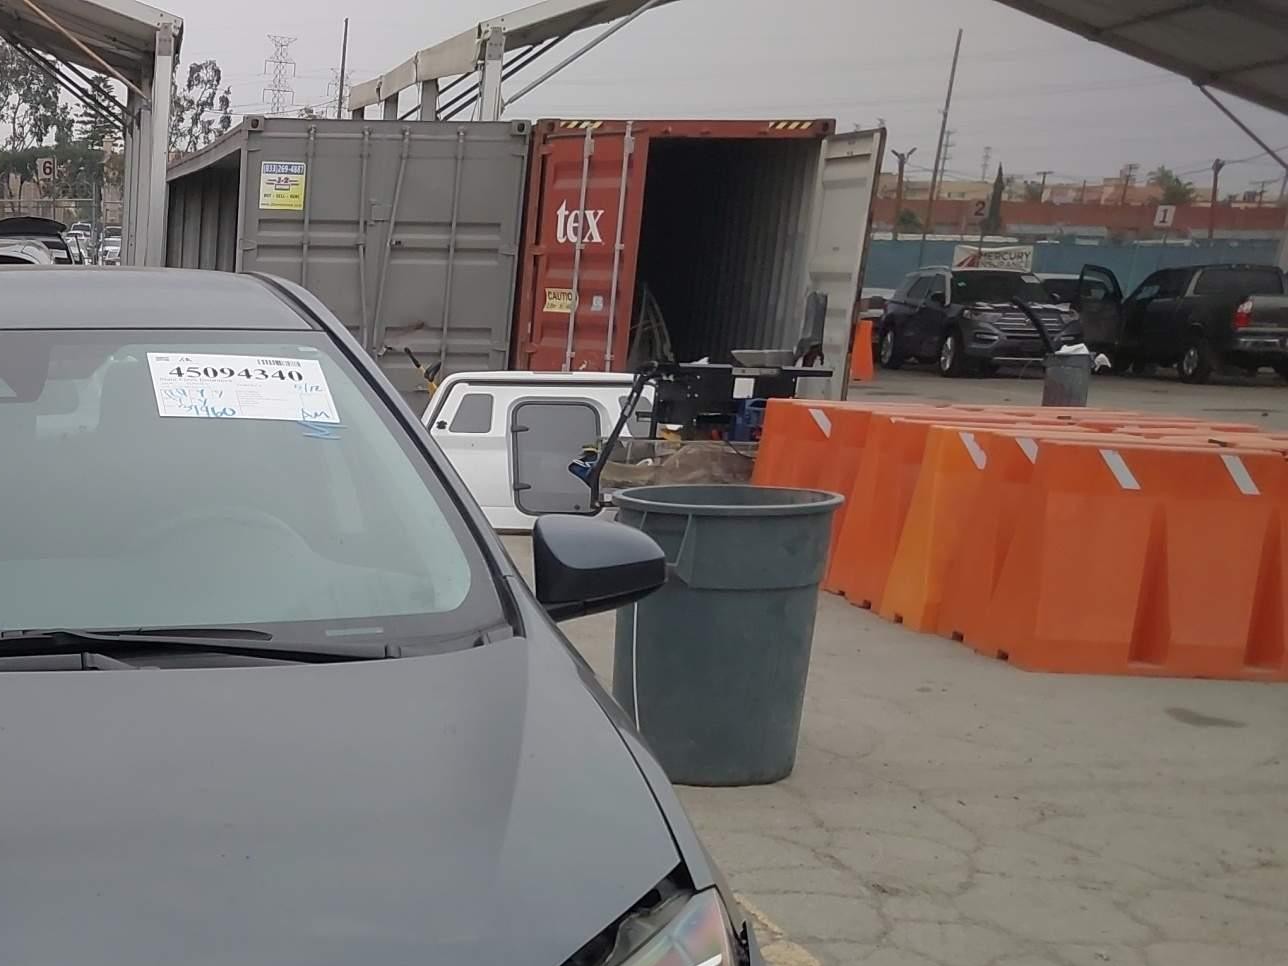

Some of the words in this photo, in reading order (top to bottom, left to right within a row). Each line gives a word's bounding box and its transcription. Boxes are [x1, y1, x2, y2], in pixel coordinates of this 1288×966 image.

[42, 160, 53, 176] 6
[974, 200, 986, 216] 2
[1159, 208, 1169, 223] 1
[556, 199, 604, 243] tex
[548, 291, 577, 301] CAUTIO
[169, 365, 303, 382] 45094340
